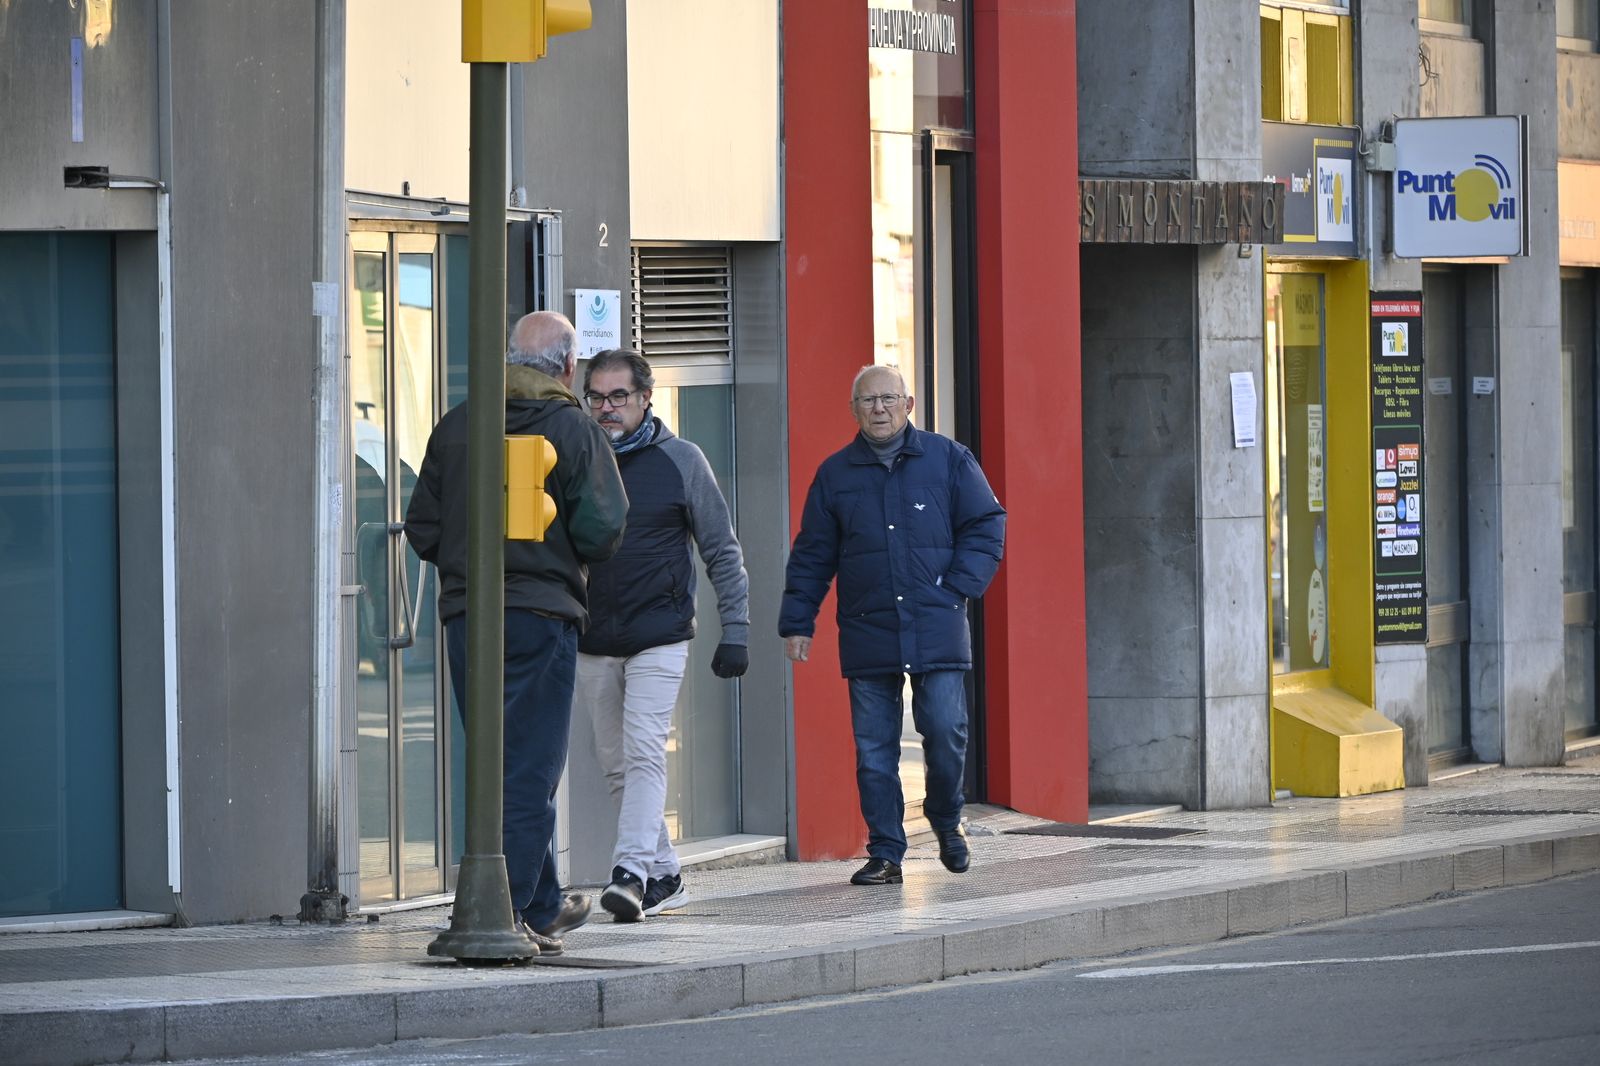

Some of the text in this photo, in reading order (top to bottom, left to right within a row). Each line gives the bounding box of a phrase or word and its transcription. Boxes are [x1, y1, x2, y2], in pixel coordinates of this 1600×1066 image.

[870, 8, 903, 48] HUELVA
[912, 11, 957, 55] PROVINCIA
[1117, 193, 1276, 230] MONTANO
[599, 222, 608, 247] 2
[582, 328, 614, 338] meridianos
[1411, 364, 1420, 372] cost
[1395, 386, 1419, 396] Reparaciones
[1386, 397, 1395, 407] ADSL
[1399, 397, 1409, 406] Fibra
[1398, 445, 1418, 460] simyo
[1400, 462, 1416, 475] Lowi
[1400, 479, 1419, 491] Jazztel
[1377, 493, 1394, 503] orange
[1398, 524, 1420, 537] finetwork
